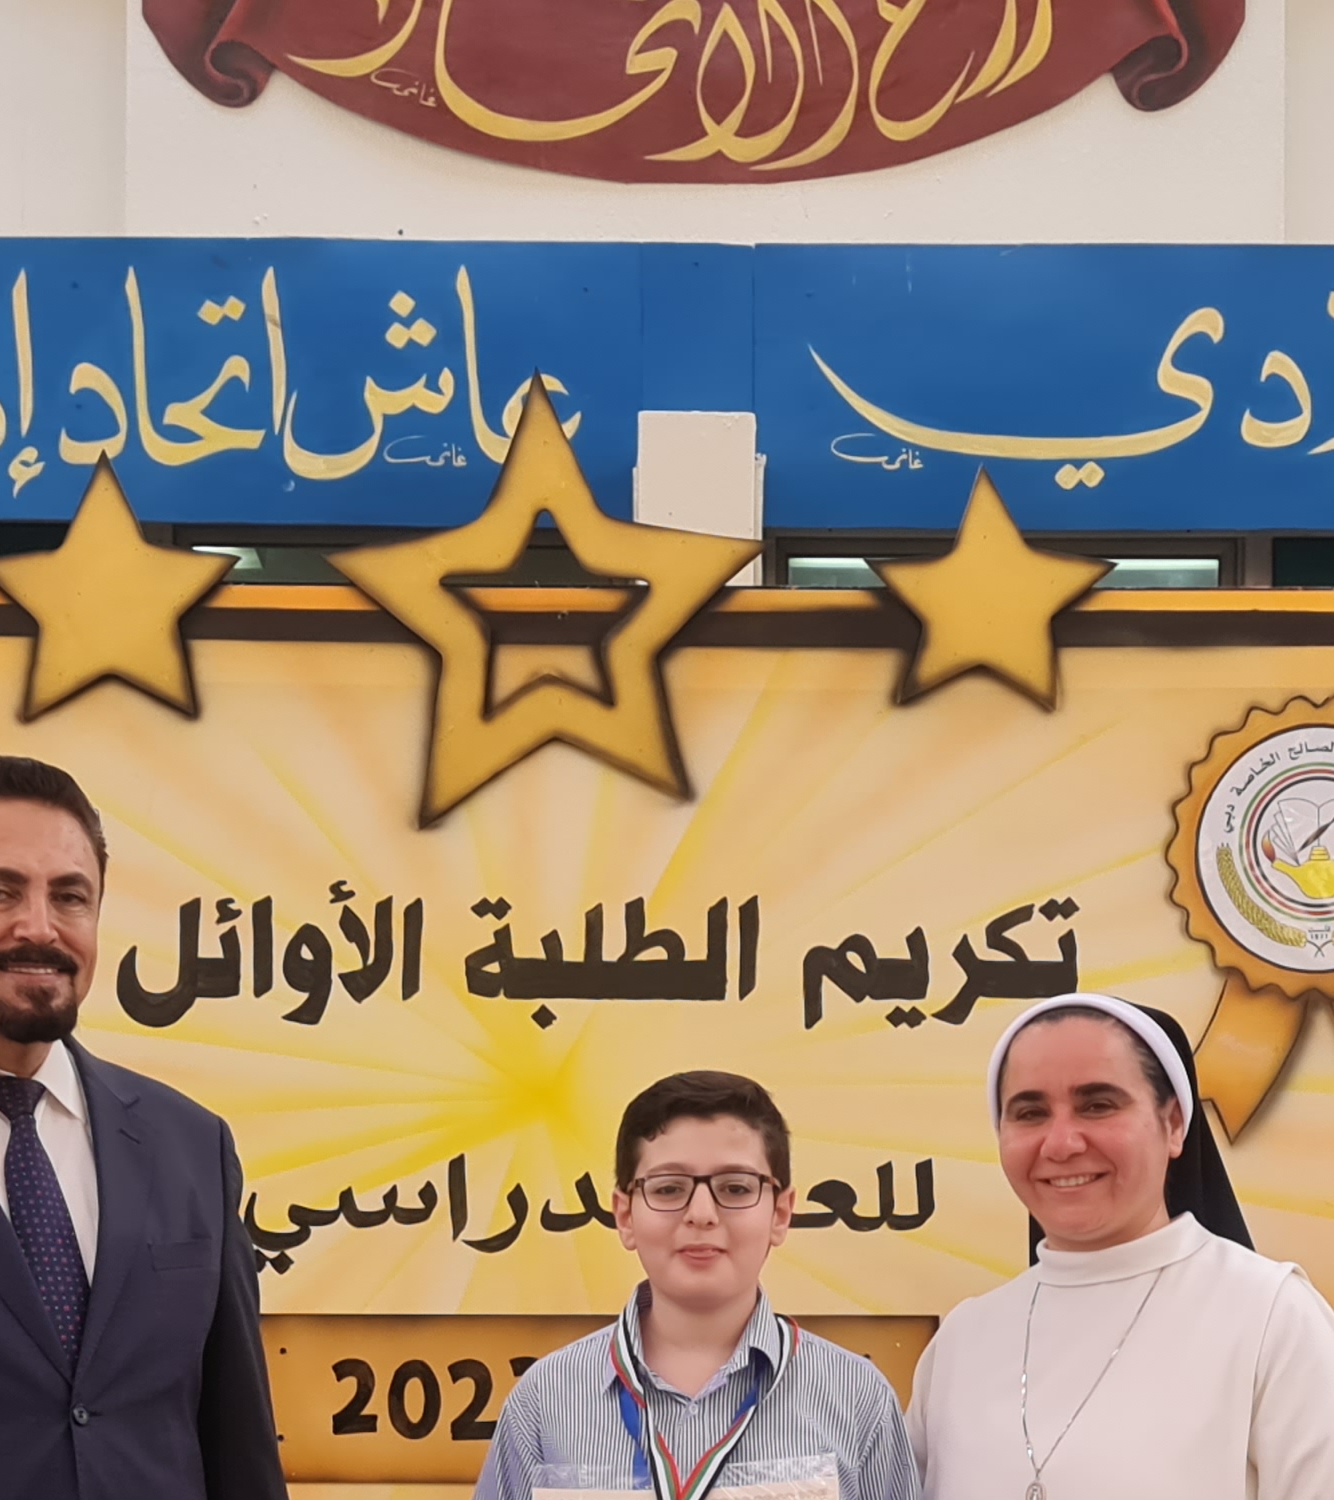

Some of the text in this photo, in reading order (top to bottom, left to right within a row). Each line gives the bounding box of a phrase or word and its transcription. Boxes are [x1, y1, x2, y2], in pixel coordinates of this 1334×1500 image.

[59, 266, 286, 468] اتحاد
[115, 879, 1081, 1031] تكريم الطلبة الأوائل
[243, 1152, 936, 1275] للع دراسي
[330, 1355, 540, 1441] 202
